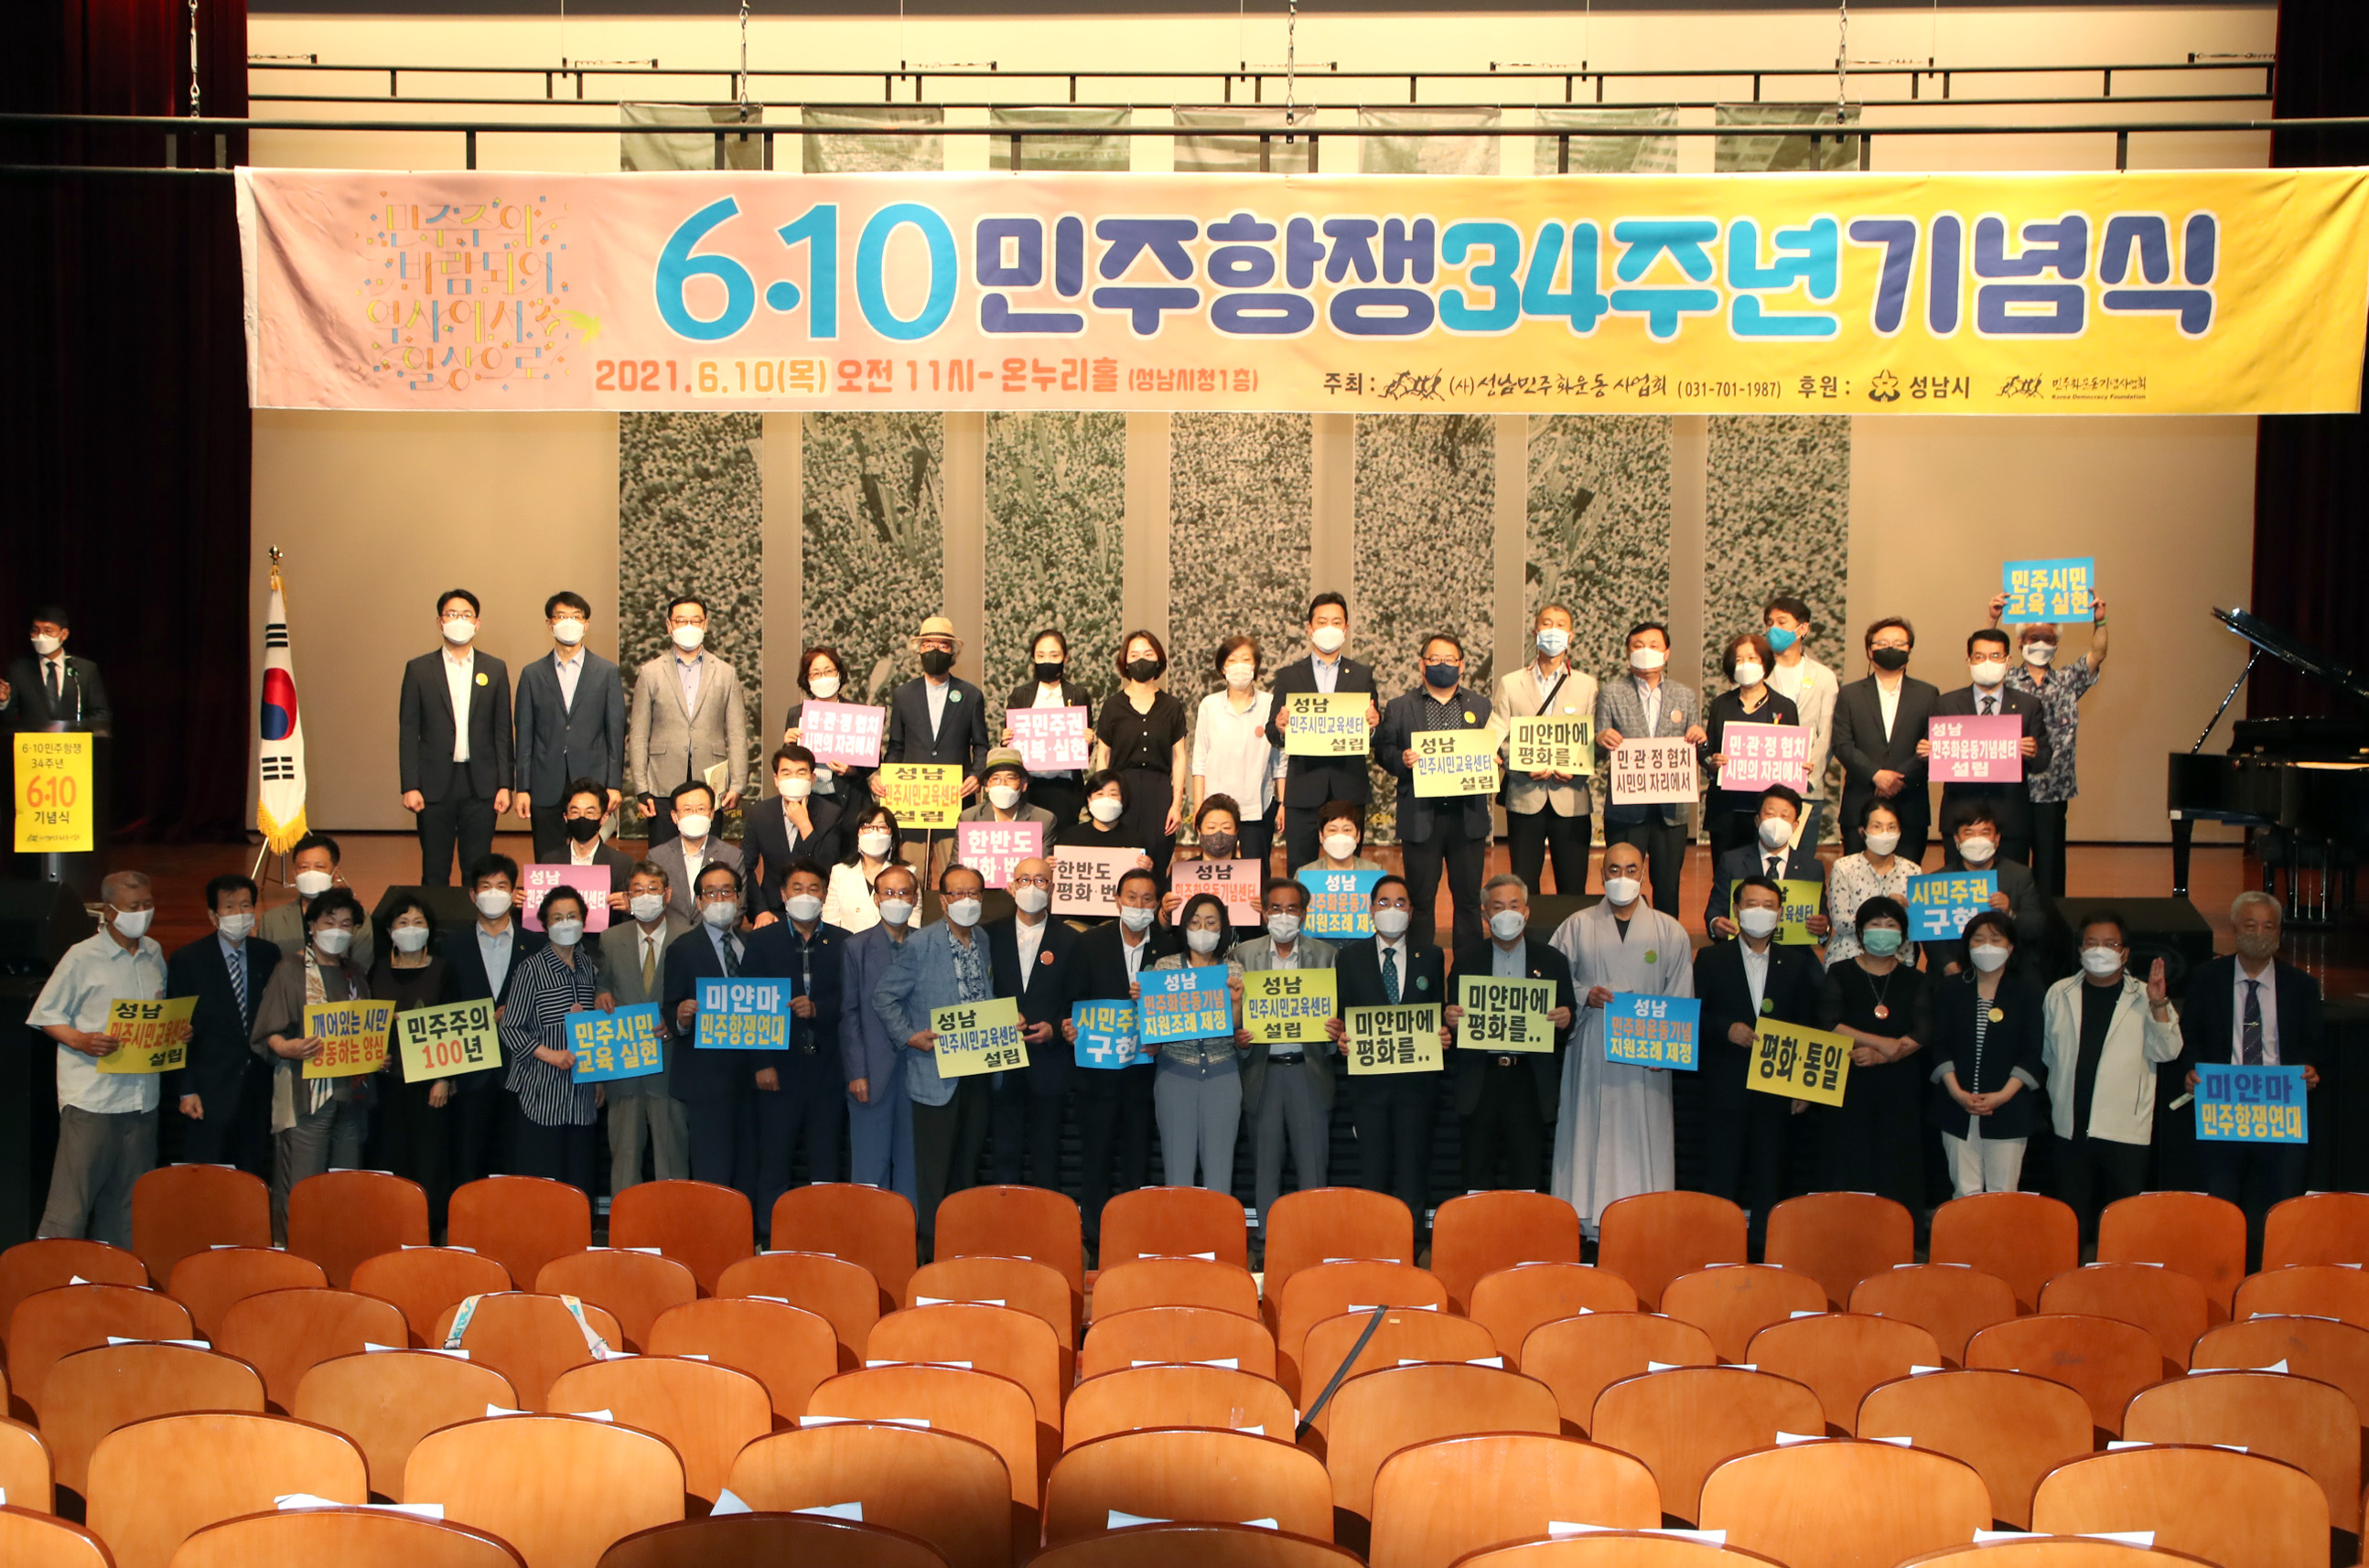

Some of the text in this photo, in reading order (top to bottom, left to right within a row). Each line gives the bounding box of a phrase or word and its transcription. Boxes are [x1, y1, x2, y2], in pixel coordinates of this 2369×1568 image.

[836, 359, 893, 393] 오전
[1128, 368, 1258, 392] (성남시청1층)
[1677, 381, 1782, 398] (031-701-1987)
[1909, 376, 1970, 399] 성남시
[2011, 566, 2086, 594] 민주시민
[2008, 591, 2089, 615] 교육 실현
[1293, 697, 1330, 714] 성남
[1015, 712, 1083, 738] 국민주권
[1289, 715, 1363, 734] 민주시민교육센터
[1519, 722, 1588, 746] 미얀마에
[1932, 722, 1963, 737] 성남
[1330, 737, 1363, 752] 설립
[1419, 736, 1456, 755] 성남
[1780, 736, 1806, 758] 협치
[1932, 739, 2017, 759] 민주화운동기념센터
[31, 758, 64, 769] 34주년
[1417, 755, 1492, 776] 민주시민교육센터
[1667, 747, 1691, 769] 협치
[894, 767, 946, 780] 성남
[1616, 771, 1691, 793] 시민의 자리에서
[1726, 758, 1803, 783] 시민의 자리에서
[885, 783, 959, 807] 민주시민교육센터
[1459, 776, 1494, 790] 설립
[35, 811, 70, 824] 기념식
[967, 830, 1033, 854] 한반도
[529, 870, 561, 886] 성남
[1057, 861, 1112, 880] 한반도
[1195, 865, 1233, 880] 성남
[1325, 875, 1357, 892] 성남
[1911, 878, 1989, 905] 시민주권
[1163, 972, 1198, 992] 성남
[1262, 976, 1303, 995] 성남
[115, 1003, 164, 1019] 성남
[705, 984, 781, 1014] 미얀마
[1144, 989, 1225, 1016] 민주화운동기념
[1248, 996, 1331, 1020] 민주시민교육센터
[1468, 984, 1549, 1015] 미얀마에
[1633, 998, 1668, 1018] 성남
[312, 1008, 389, 1037] 깨어있는 시민
[407, 1006, 490, 1044] 민주주의
[575, 1013, 655, 1049] 민주시민
[700, 1013, 785, 1046] 민주항쟁연대
[937, 1009, 977, 1031] 성남
[1144, 1009, 1227, 1036] 지원조례 제정
[1264, 1022, 1302, 1038] 설립
[1355, 1009, 1435, 1036] 미얀마에
[1611, 1016, 1693, 1042] 민주화운동기념
[363, 1036, 384, 1061] 양심
[422, 1035, 484, 1069] 100년
[939, 1025, 1019, 1055] 민주시민교육센터
[1086, 1035, 1138, 1063] 구현
[1610, 1037, 1693, 1064] 지원조례 제정
[576, 1039, 659, 1073] 교육 실현
[984, 1047, 1021, 1069] 설립
[2206, 1073, 2293, 1104] 미얀마
[2202, 1103, 2302, 1138] 민주항쟁연대
